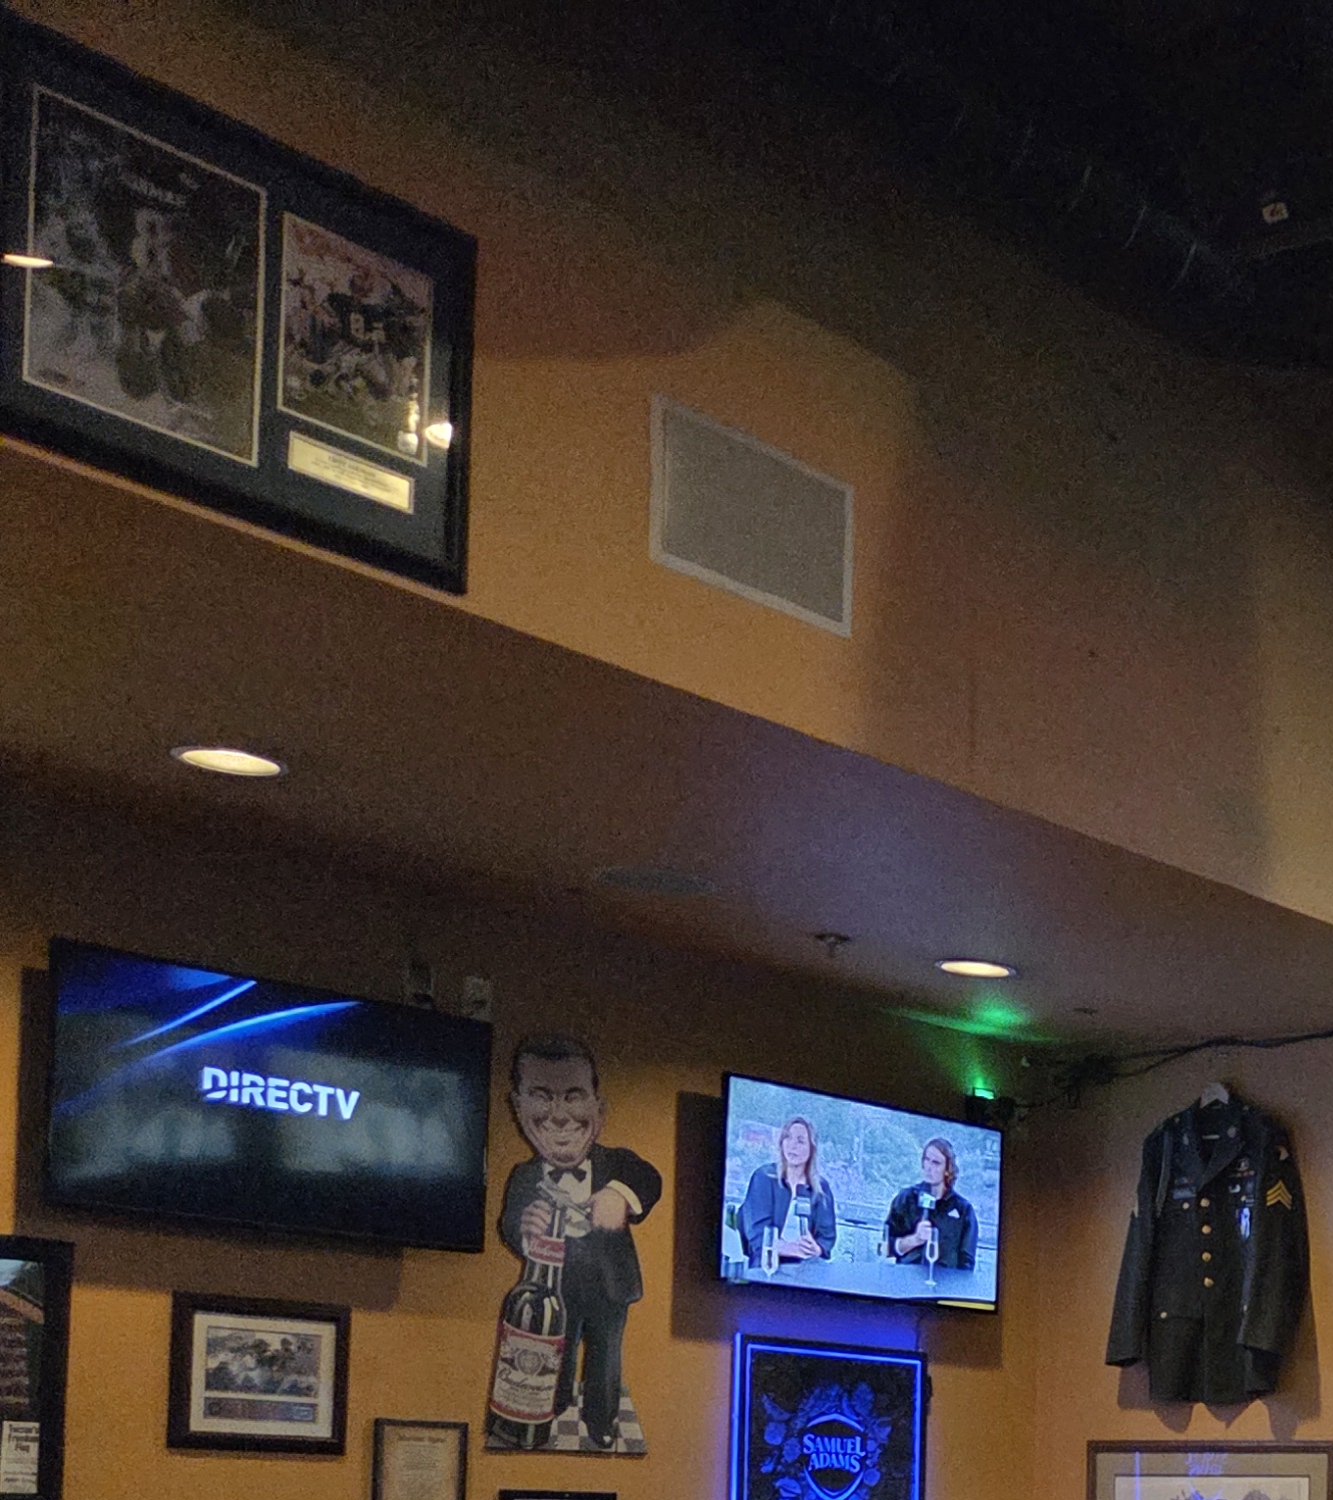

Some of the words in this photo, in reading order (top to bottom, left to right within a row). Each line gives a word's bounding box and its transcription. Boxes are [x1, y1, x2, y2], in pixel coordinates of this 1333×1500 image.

[201, 1065, 361, 1121] DIRECTV
[803, 1434, 866, 1456] SAMUEL
[808, 1453, 860, 1473] ADAMS
